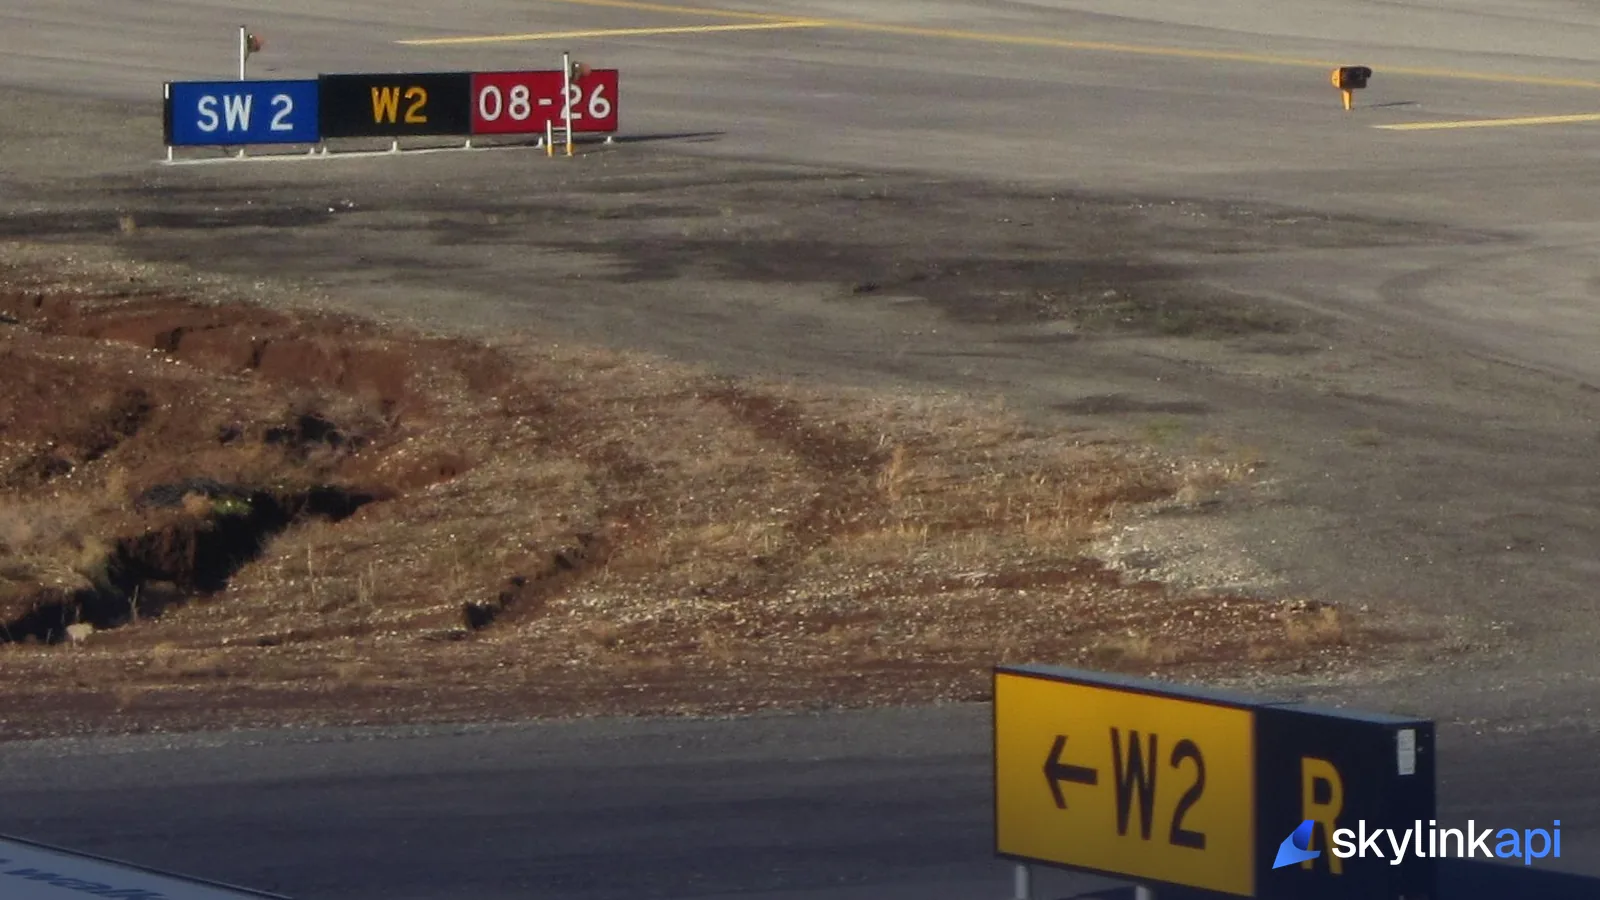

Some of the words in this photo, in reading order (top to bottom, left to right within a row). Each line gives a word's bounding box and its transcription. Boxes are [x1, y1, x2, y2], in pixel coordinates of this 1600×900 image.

[196, 94, 252, 133] SW
[269, 93, 294, 132] 2
[371, 87, 428, 124] W2
[478, 84, 612, 120] 08-26
[1110, 727, 1209, 850] W2
[1301, 756, 1344, 876] R
